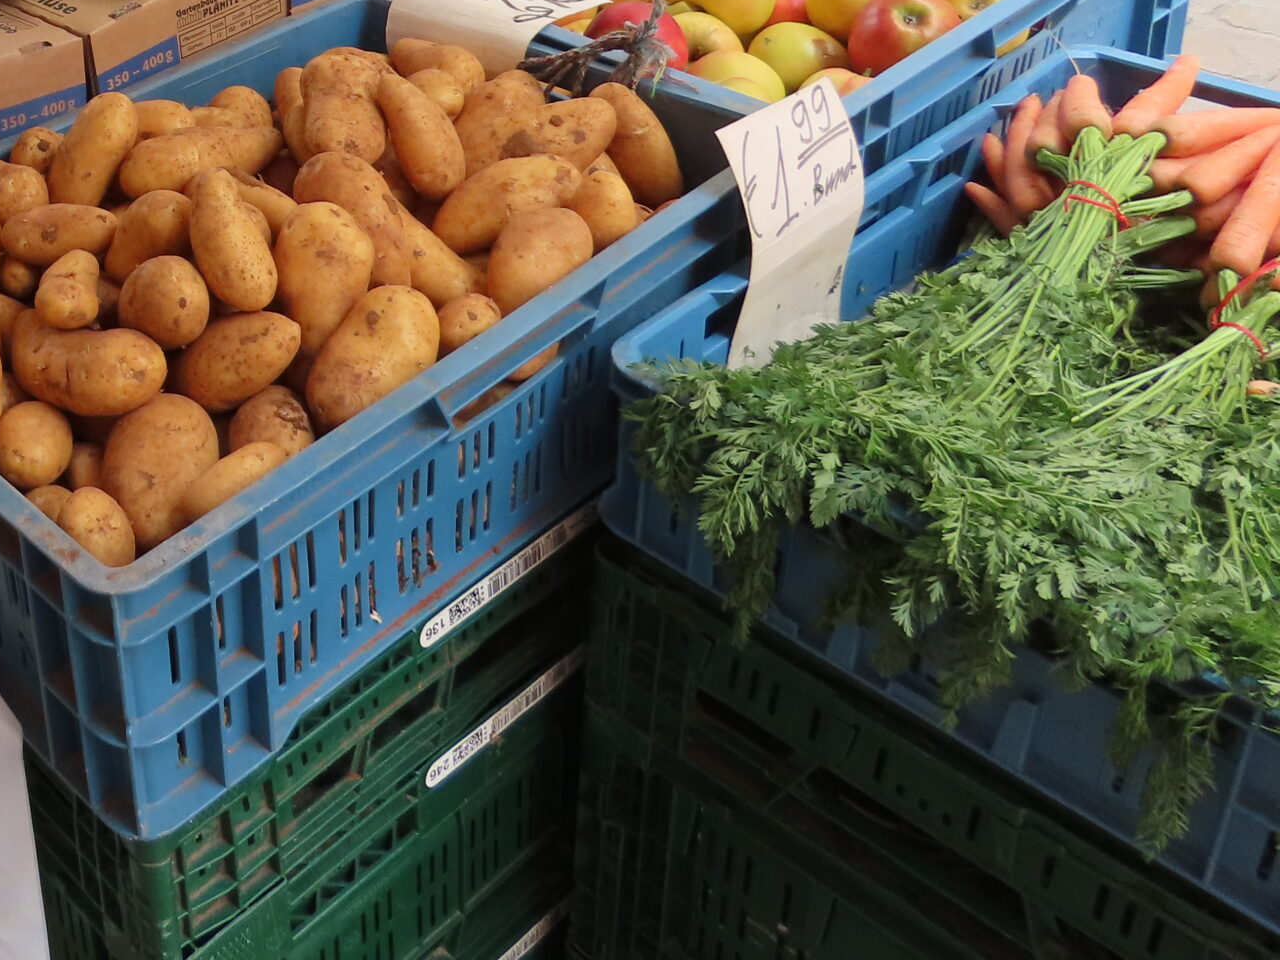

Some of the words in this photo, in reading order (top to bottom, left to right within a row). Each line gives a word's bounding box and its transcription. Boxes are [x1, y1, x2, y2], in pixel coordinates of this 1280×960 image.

[107, 71, 129, 90] 350
[1, 114, 26, 131] 350
[425, 617, 445, 640] 136
[430, 757, 450, 782] 246
